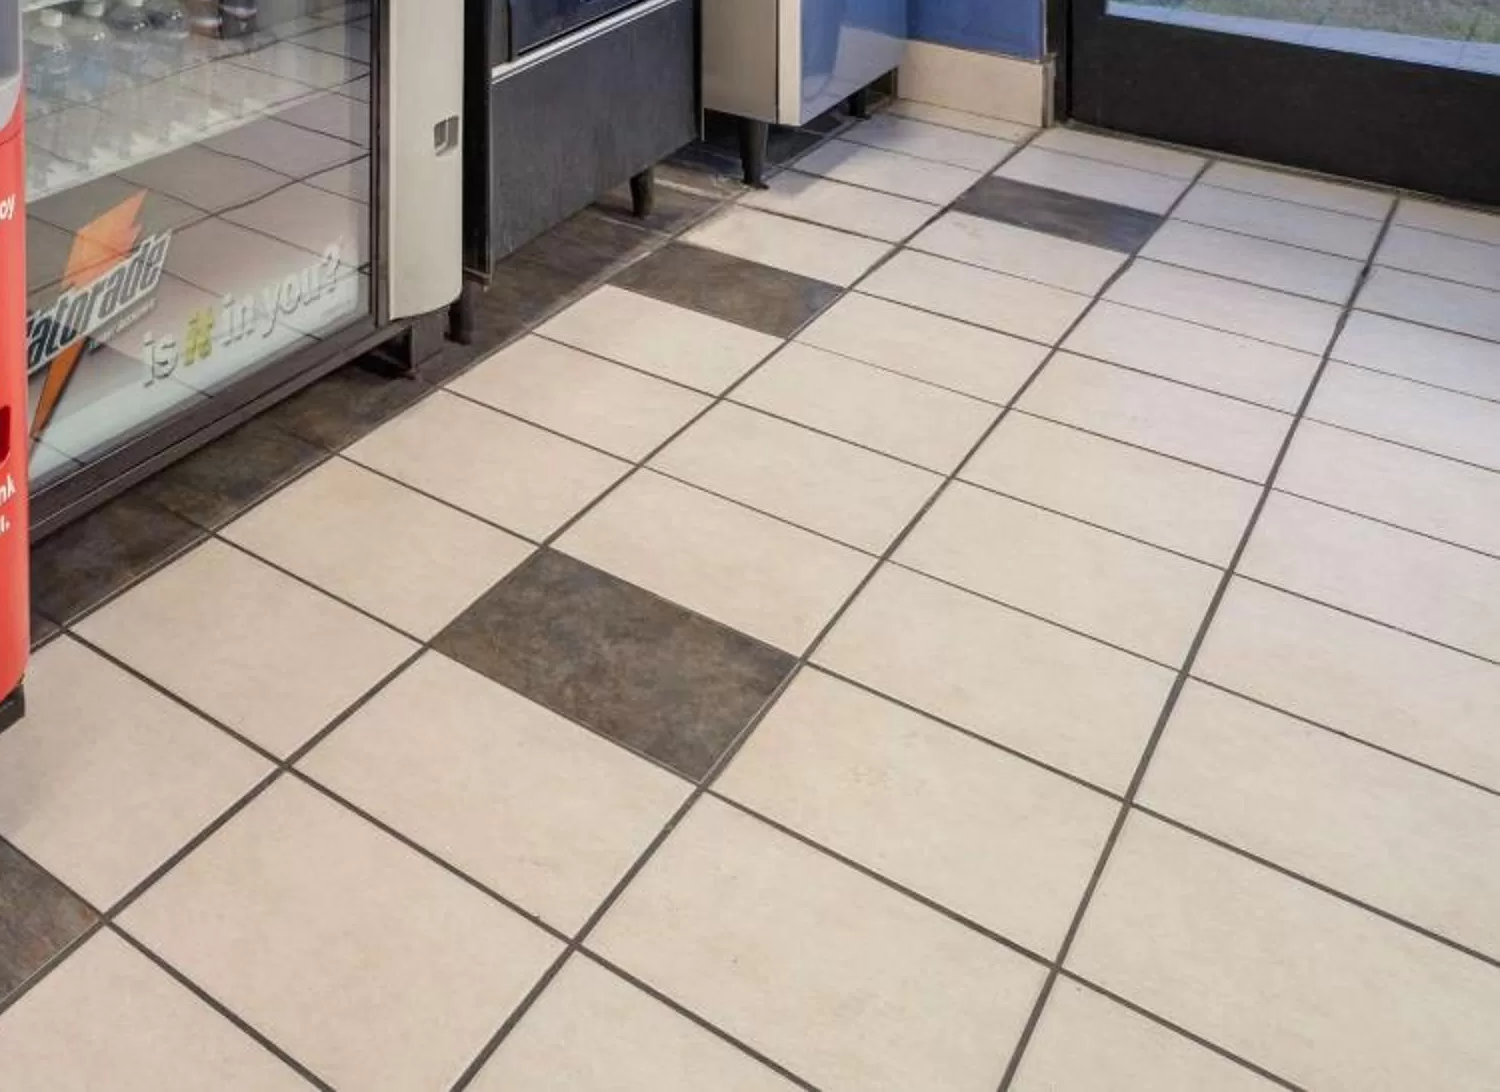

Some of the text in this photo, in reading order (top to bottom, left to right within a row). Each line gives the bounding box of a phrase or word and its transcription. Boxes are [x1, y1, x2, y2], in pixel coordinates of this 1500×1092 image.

[27, 233, 171, 375] atorade
[141, 331, 180, 388] is
[183, 306, 215, 367] it
[218, 291, 255, 348] in
[261, 243, 341, 339] you?
